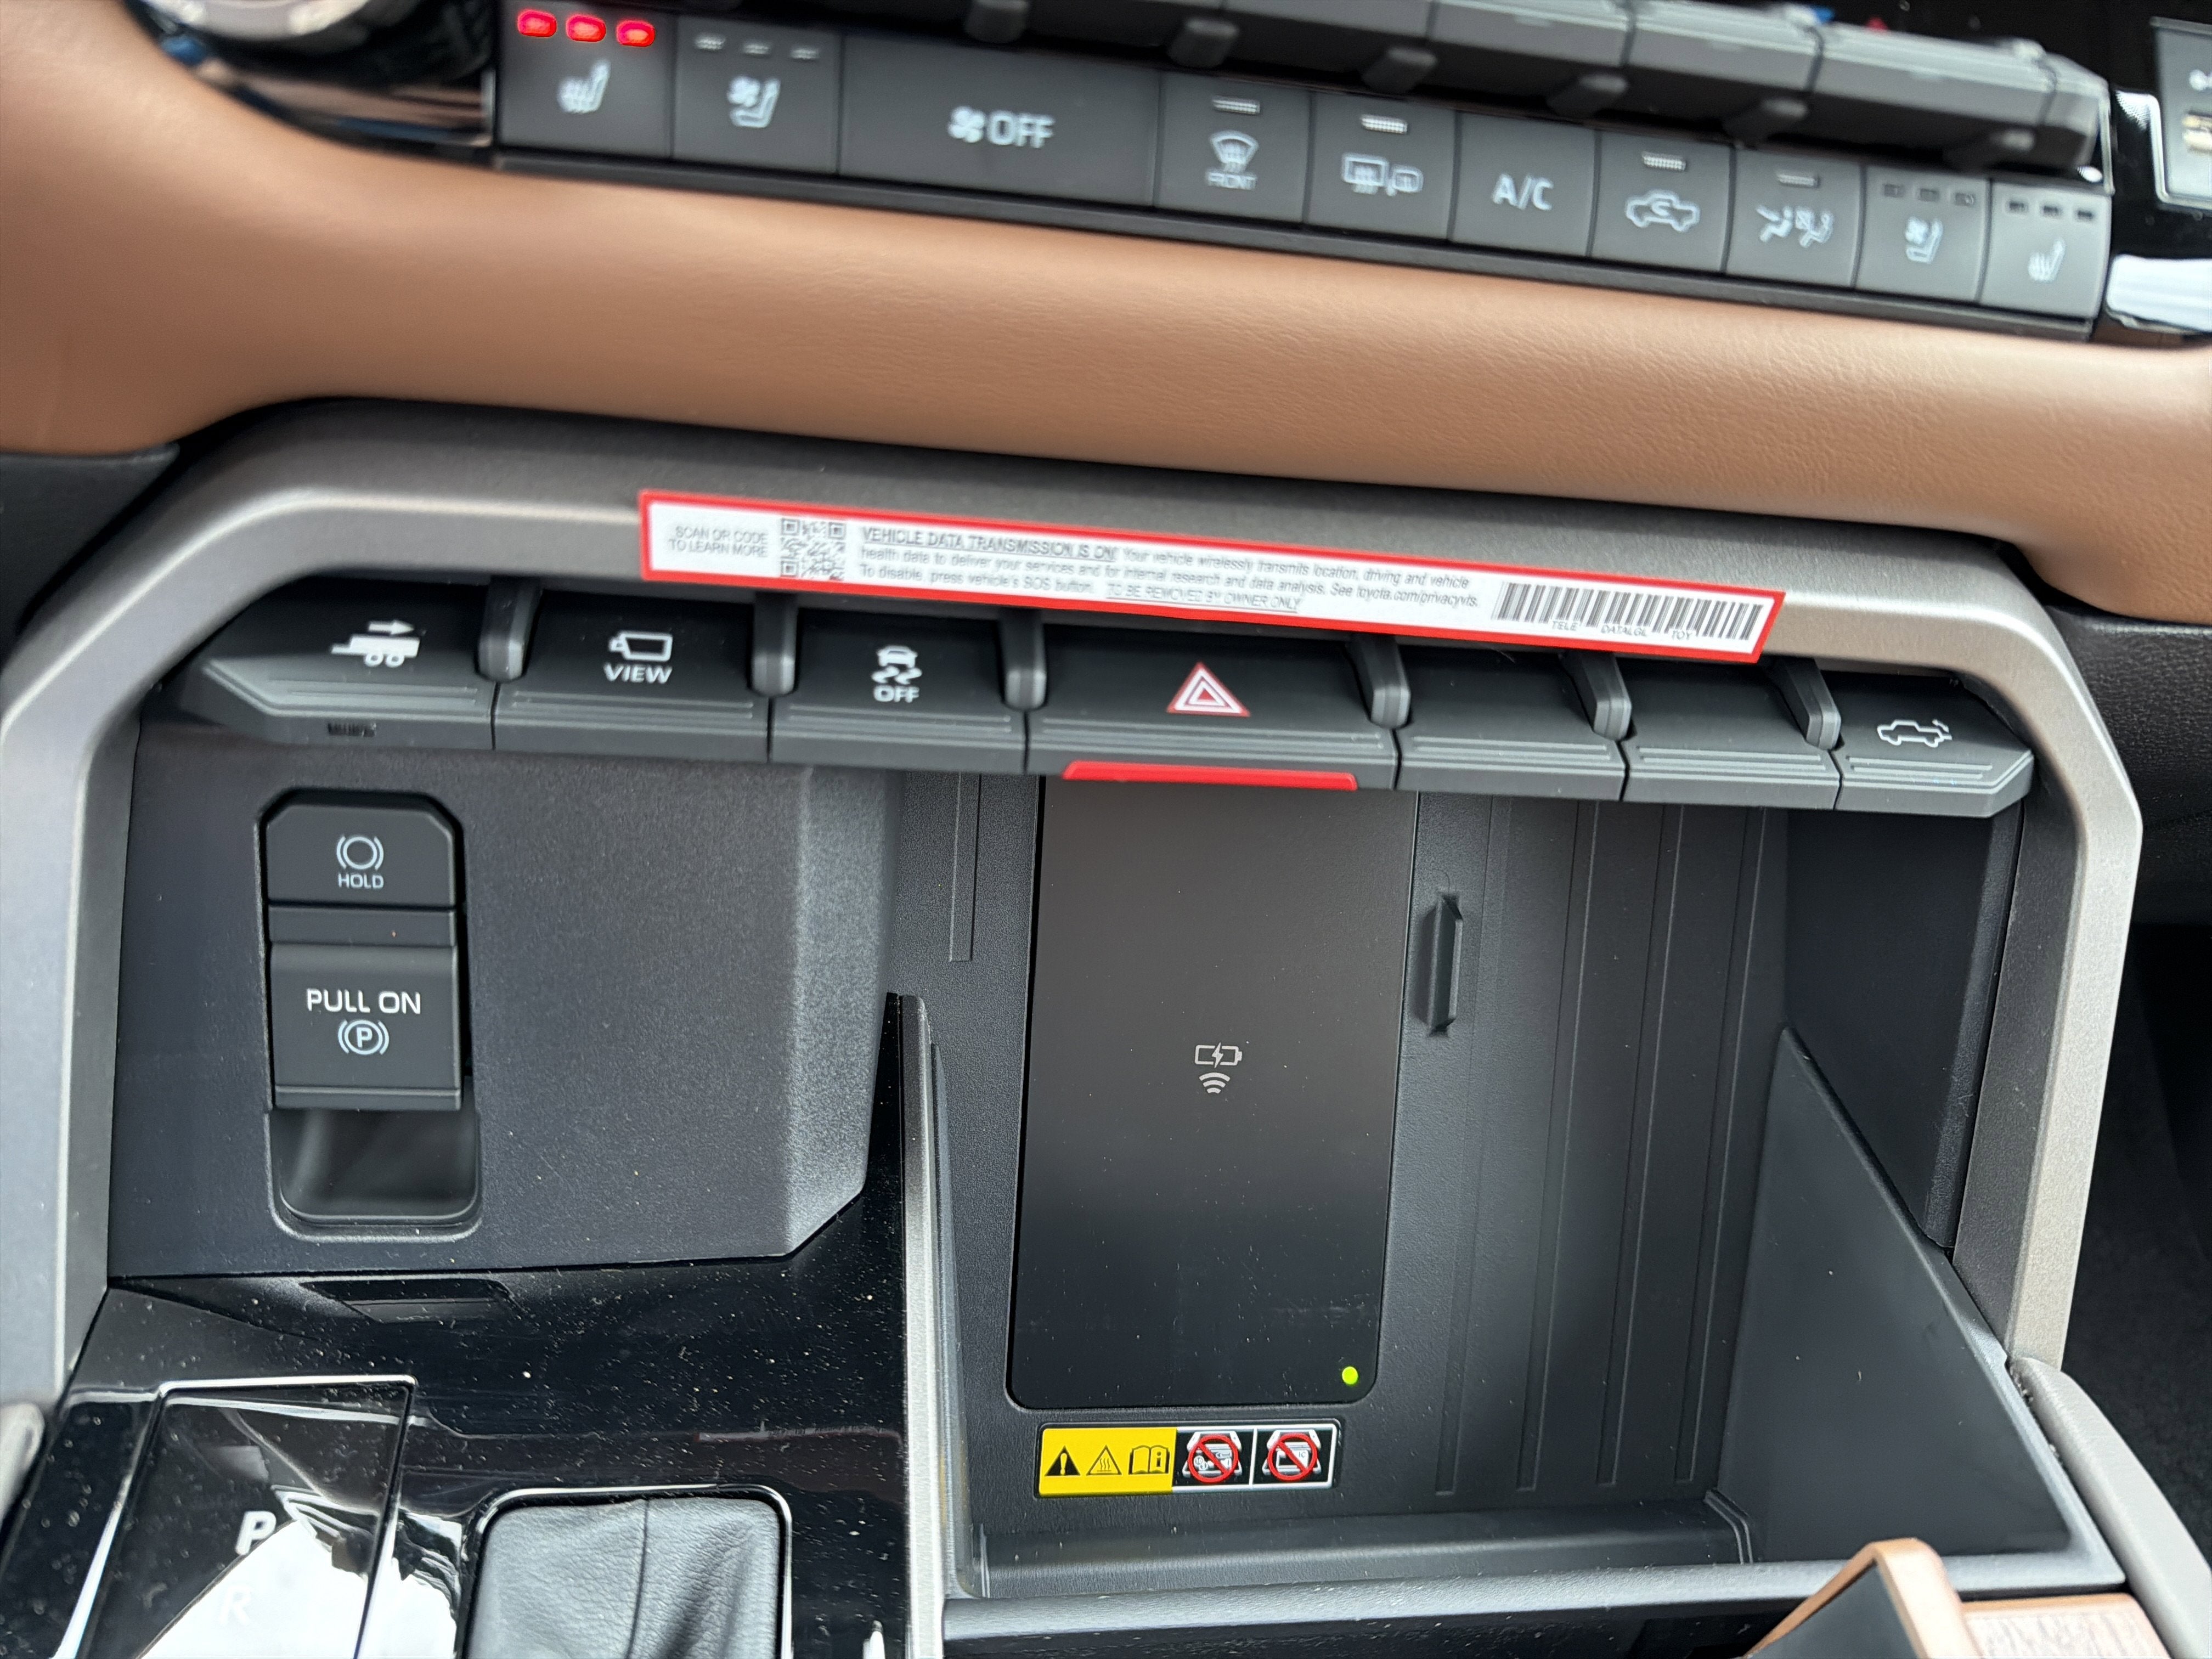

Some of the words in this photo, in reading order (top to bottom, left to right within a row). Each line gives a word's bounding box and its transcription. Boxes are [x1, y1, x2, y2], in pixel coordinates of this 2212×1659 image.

[989, 110, 1054, 148] OFF
[1207, 171, 1257, 190] FRONT
[1491, 173, 1554, 211] A/C
[668, 539, 686, 551] TO
[689, 540, 729, 554] LEARN
[732, 544, 768, 557] MORE
[675, 526, 709, 539] SCAN
[734, 531, 769, 544] CODE
[862, 526, 926, 545] VEHICLE
[928, 532, 963, 548] DATA
[968, 535, 1074, 556] TRANSMISSION
[1077, 544, 1089, 558] IS
[1123, 547, 1150, 562] Your
[1153, 551, 1193, 566] vehicle
[1198, 555, 1252, 572] wirelessly
[1259, 560, 1308, 575] transmits
[1363, 568, 1401, 585] driving
[1405, 572, 1425, 585] and
[1430, 574, 1469, 589] vehicle
[860, 563, 874, 578] To
[931, 571, 964, 585] press
[968, 573, 1019, 588] vehicle's
[1024, 576, 1051, 591] SOS
[861, 546, 898, 561] health
[904, 549, 929, 564] data
[935, 552, 946, 566] to
[951, 554, 991, 568] deliver
[994, 558, 1021, 573] your
[1025, 561, 1074, 574] services
[1079, 565, 1099, 577] and
[1105, 565, 1120, 578] for
[1124, 567, 1166, 582] internal
[1171, 571, 1220, 586] research
[1224, 575, 1244, 589] and
[1249, 578, 1274, 591] data
[1330, 583, 1352, 597] See
[1107, 583, 1121, 596] TO
[1125, 585, 1141, 598] BE
[1146, 586, 1202, 602] REMOVED
[1206, 591, 1221, 603] BY
[1223, 592, 1268, 607] OWNER
[1270, 596, 1302, 610] ONLY
[1671, 630, 1693, 641] TOY
[604, 664, 673, 684] VIEW
[874, 686, 919, 703] OFF
[338, 873, 383, 889] HOLD
[306, 988, 370, 1013] PULL
[379, 991, 421, 1014] ON
[236, 1511, 276, 1555] P
[219, 1584, 252, 1626] R
